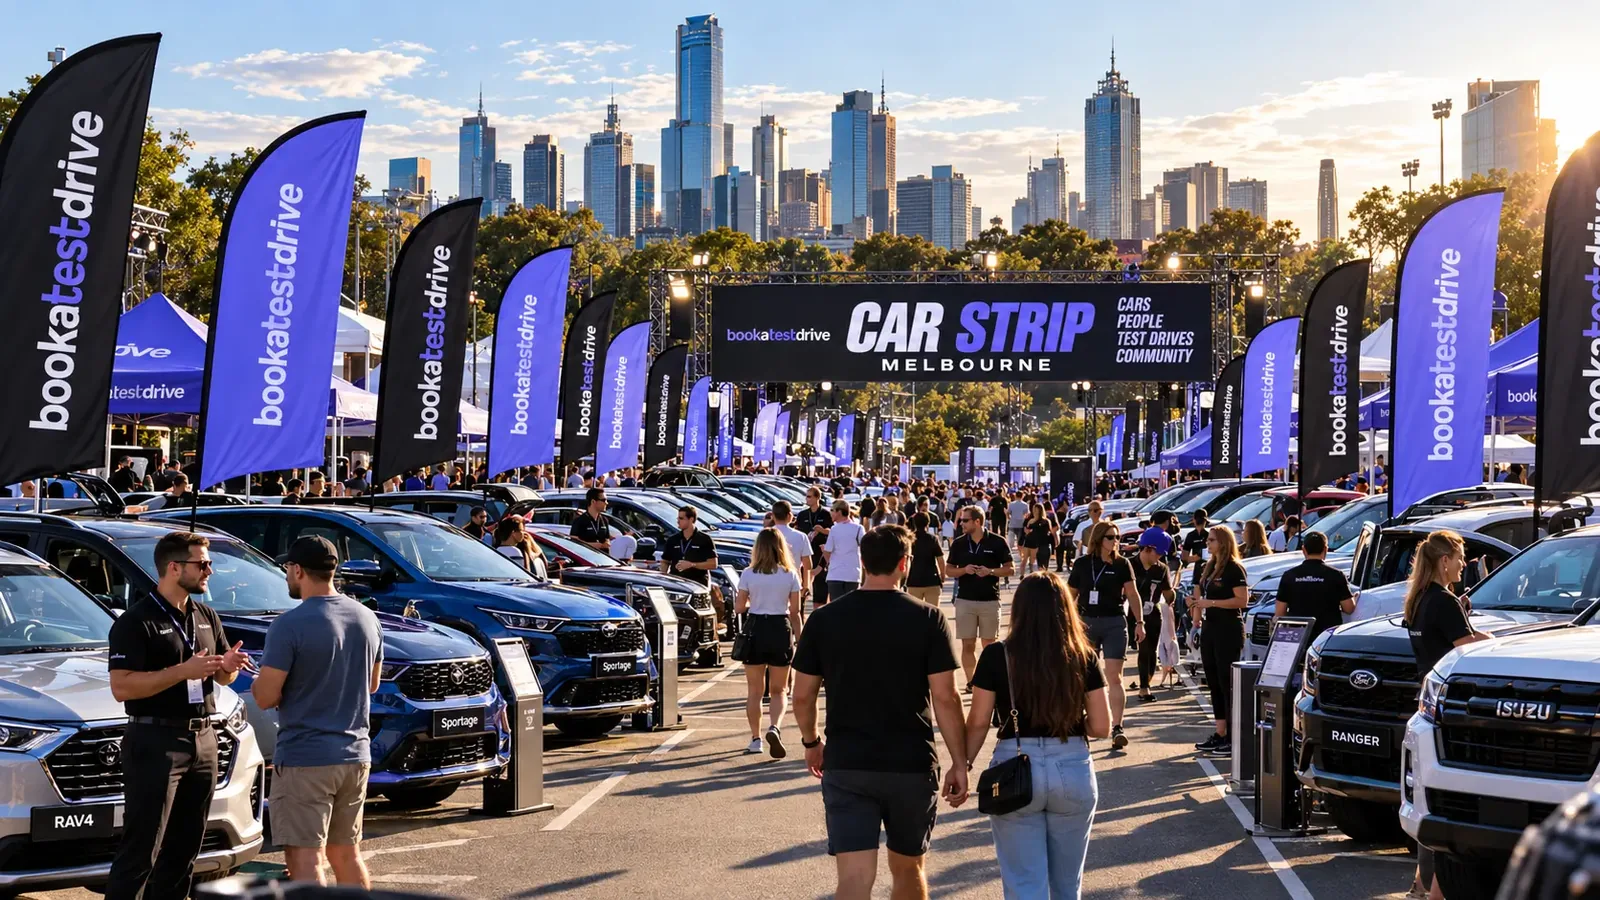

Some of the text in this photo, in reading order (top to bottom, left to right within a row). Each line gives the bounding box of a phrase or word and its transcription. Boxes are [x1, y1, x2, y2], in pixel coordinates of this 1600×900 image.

[29, 111, 103, 430] bookatestdrive
[253, 184, 303, 426] bookatestdrive
[1118, 297, 1151, 311] CARS
[846, 302, 1095, 353] CAR STRIP
[1117, 314, 1164, 328] PEOPLE
[414, 246, 450, 440] bookatestdrive
[727, 328, 830, 341] bookatestdrive
[1118, 331, 1194, 345] TEST DRIVES
[1116, 349, 1193, 363] COMMUNITY
[1428, 248, 1461, 460] bookatestdrive
[510, 295, 537, 434] bookatestdrive
[882, 359, 1050, 371] MELBOURNE
[577, 326, 596, 436] bookatestdrive
[1329, 305, 1348, 455] bookatestdrive
[610, 357, 627, 448] bookatestdrive
[1259, 352, 1275, 454] bookatestdrive
[603, 661, 631, 673] Sportage
[1496, 700, 1550, 720] ISUZU
[442, 717, 478, 730] Sportage
[1332, 731, 1379, 746] RANGER
[55, 814, 93, 828] RAV4
